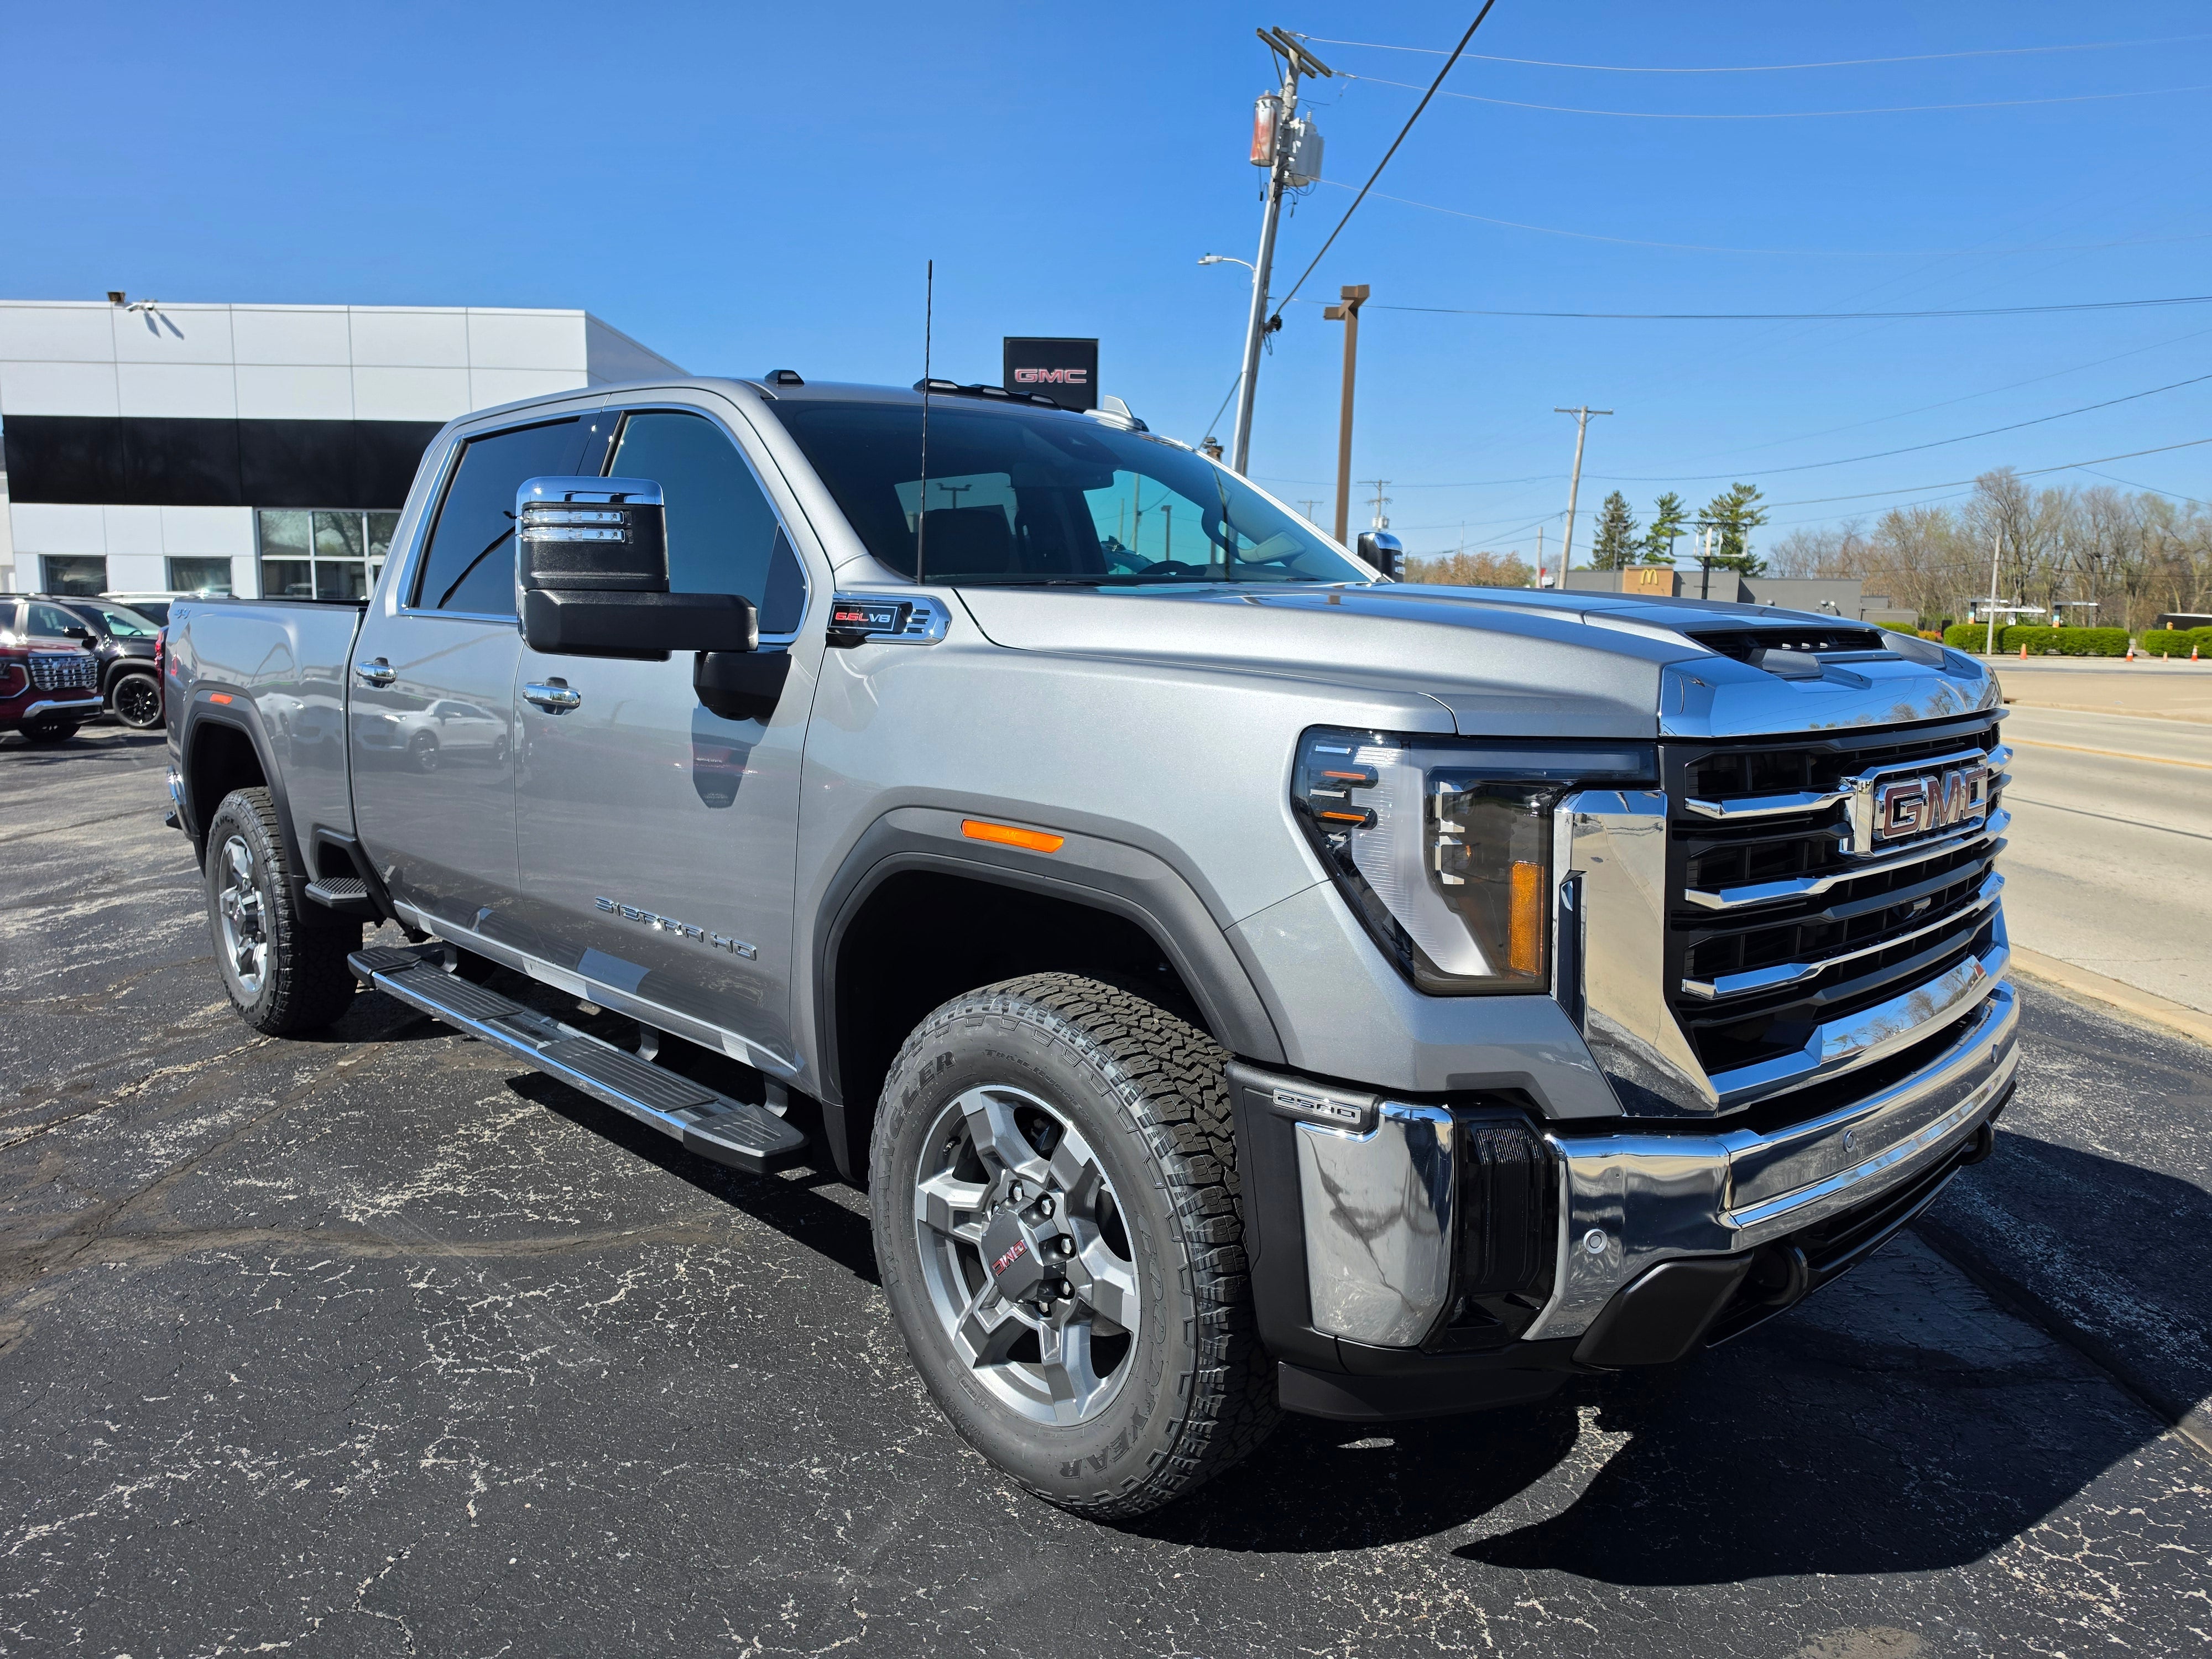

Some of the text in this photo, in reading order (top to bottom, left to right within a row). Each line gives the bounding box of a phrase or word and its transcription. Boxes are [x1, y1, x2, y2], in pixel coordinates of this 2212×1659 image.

[1014, 368, 1087, 383] GMC
[1874, 764, 1987, 841] GMC
[594, 895, 757, 962] SIERRA HD
[1277, 1094, 1356, 1119] 2500
[992, 1239, 1028, 1277] GMC
